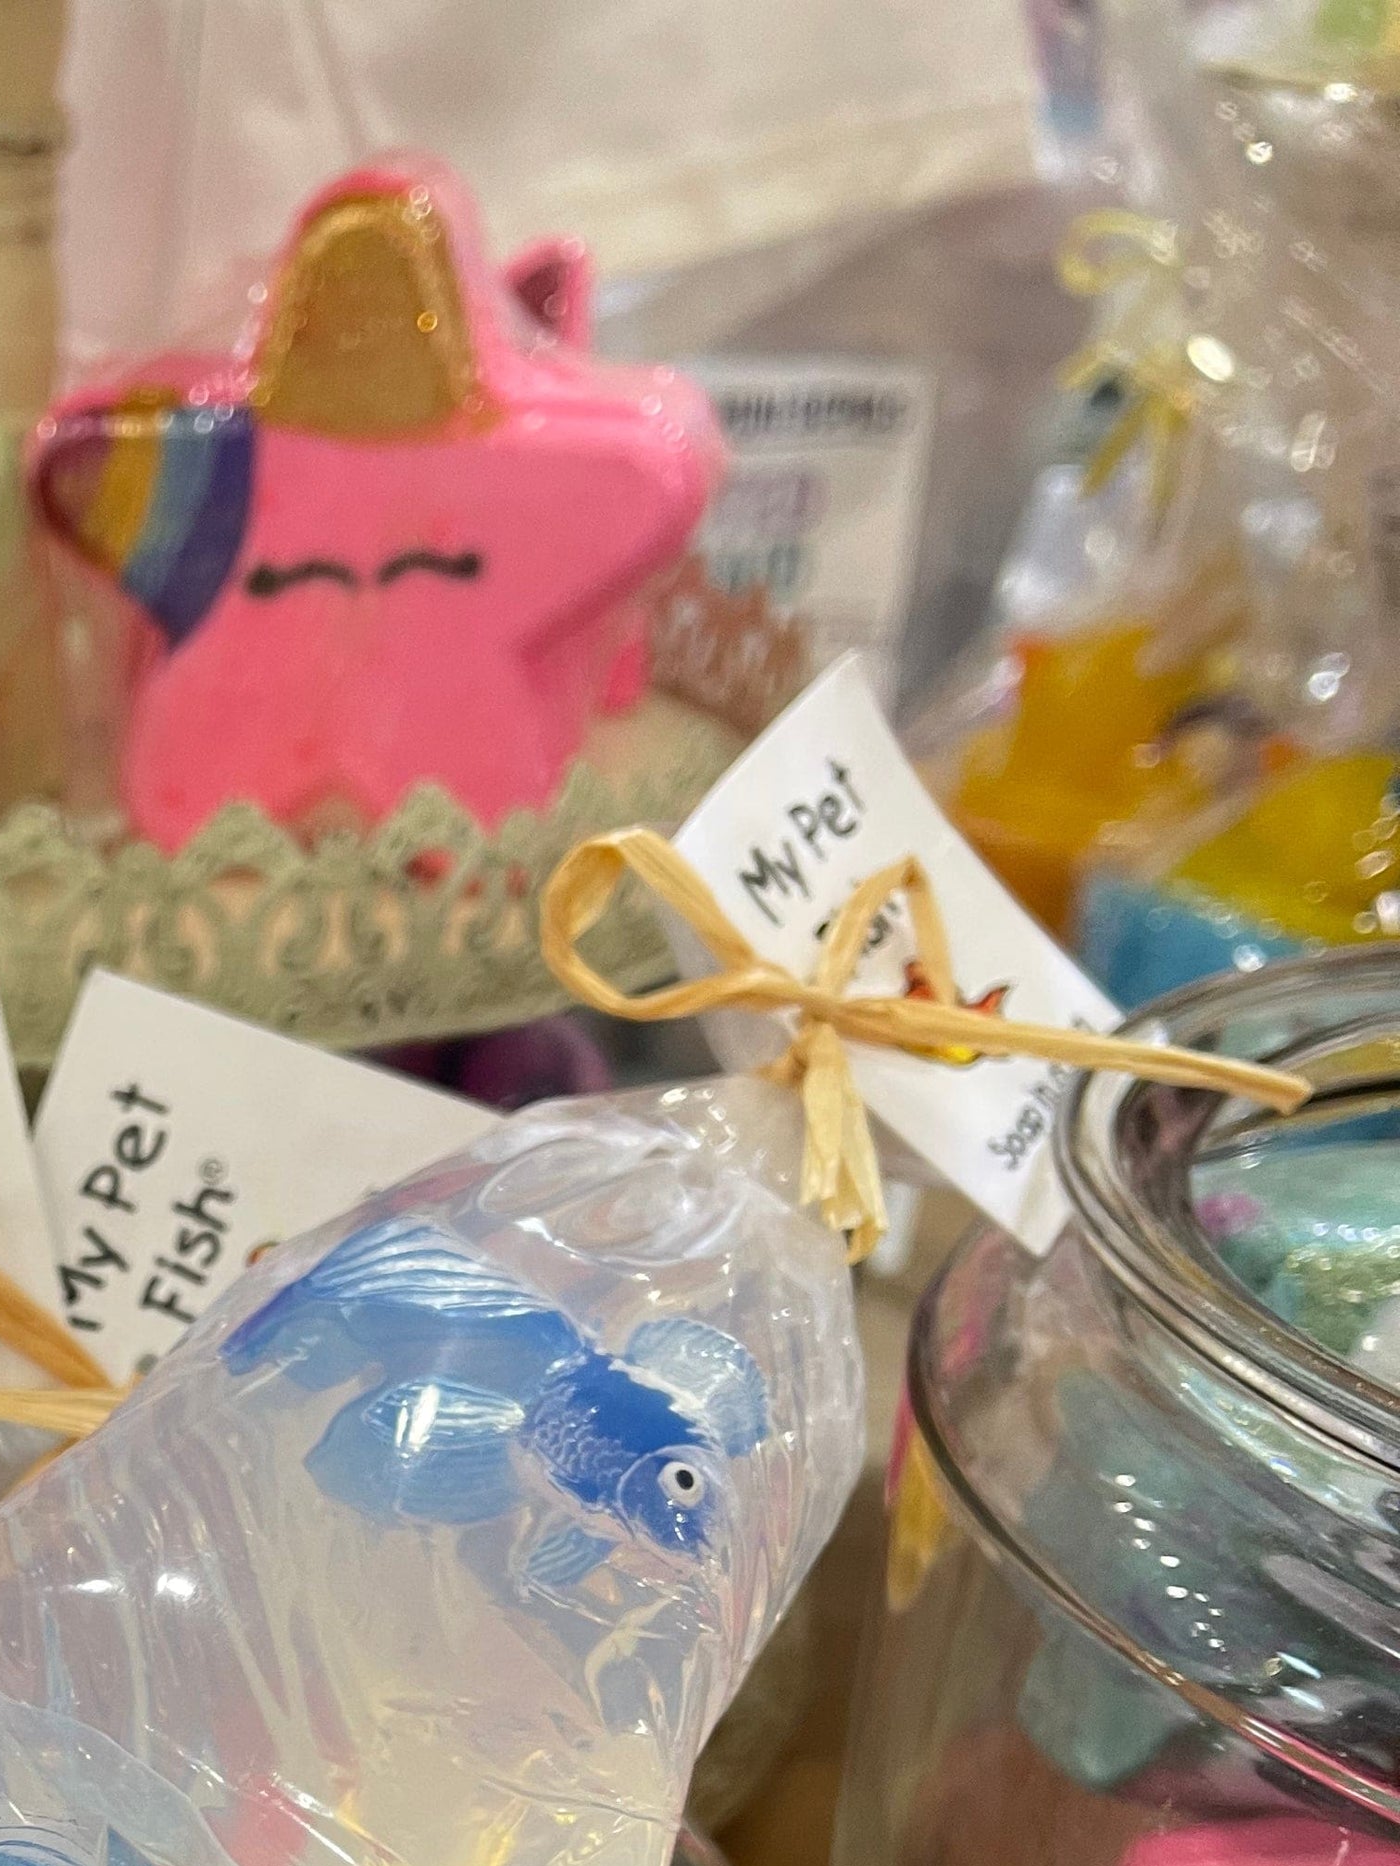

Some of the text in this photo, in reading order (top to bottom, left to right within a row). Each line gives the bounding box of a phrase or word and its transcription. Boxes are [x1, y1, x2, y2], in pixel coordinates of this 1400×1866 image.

[737, 841, 812, 928] My
[787, 757, 864, 861] Pet
[57, 1084, 170, 1332] My Pet
